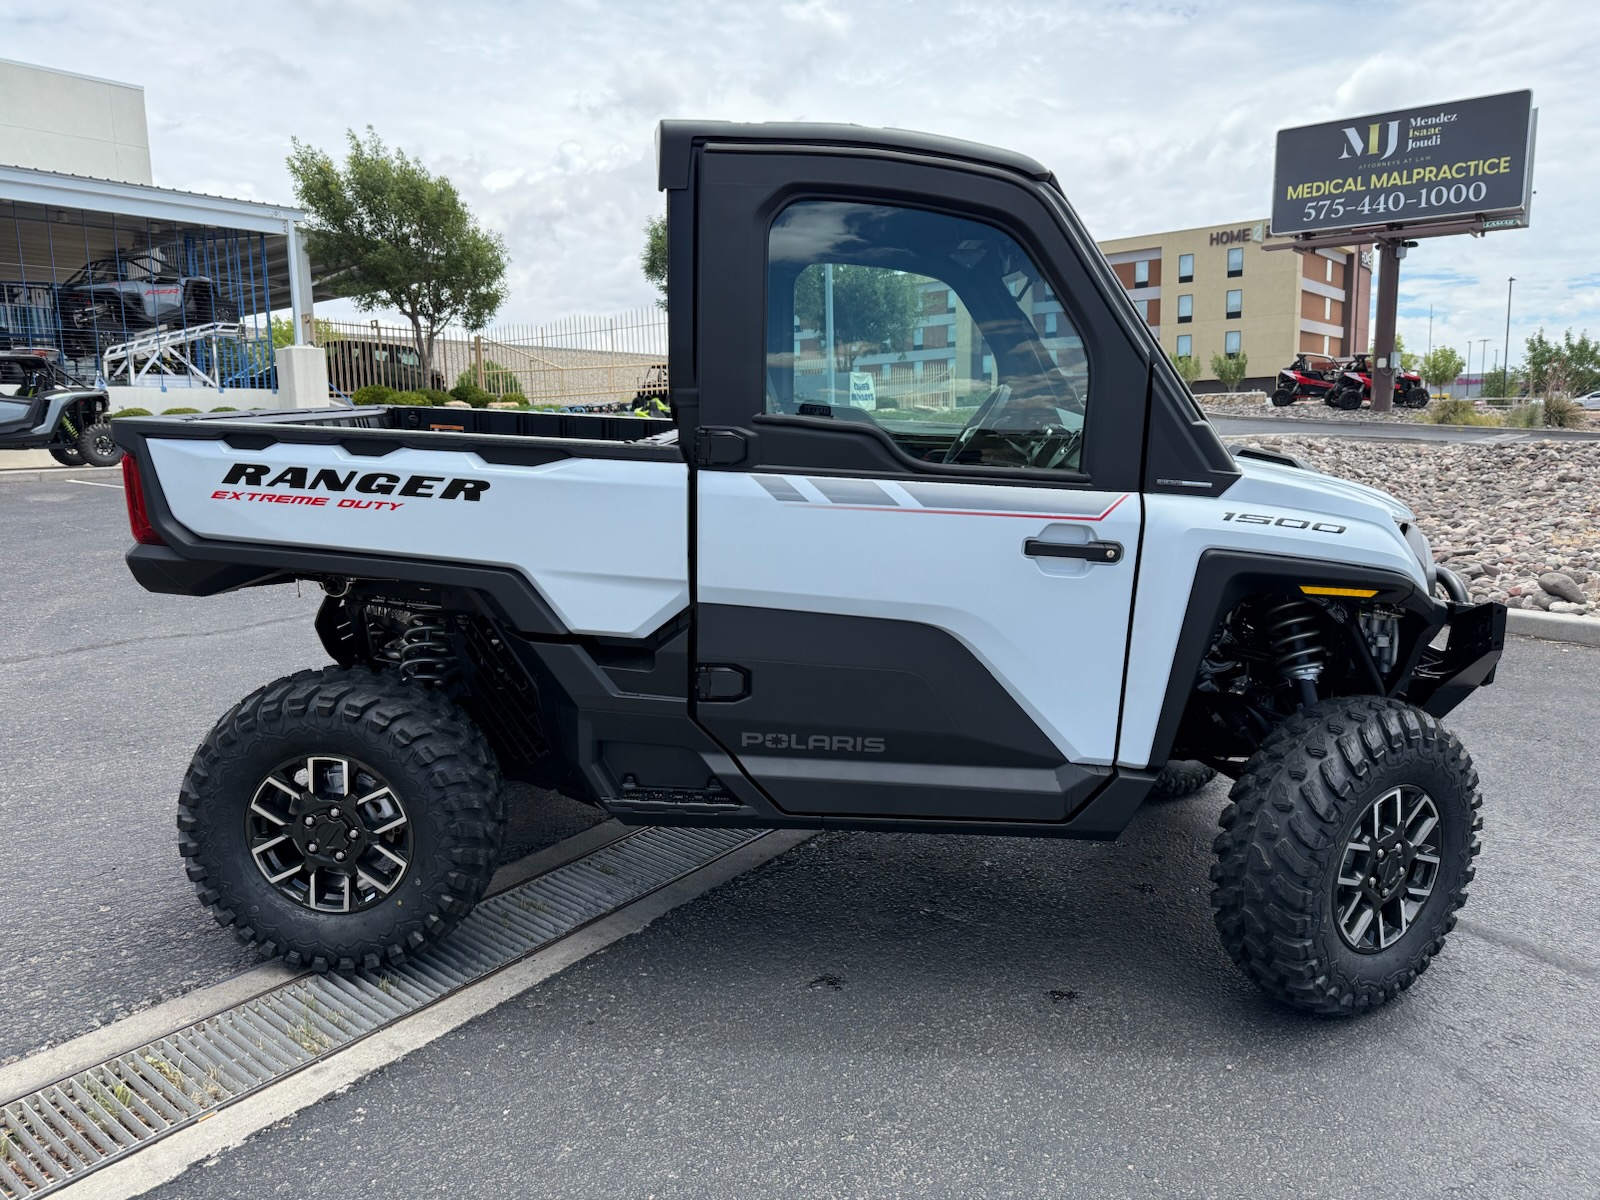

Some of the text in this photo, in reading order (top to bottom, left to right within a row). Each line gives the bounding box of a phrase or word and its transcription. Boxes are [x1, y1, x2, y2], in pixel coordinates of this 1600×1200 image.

[1409, 112, 1458, 128] Mendez
[1408, 126, 1442, 138] Isaac
[1406, 135, 1441, 153] Joudi
[1358, 155, 1432, 170] ATTORNEYS AT LAW
[1287, 156, 1511, 200] MEDICAL MALPRACTICE
[1303, 181, 1487, 222] 575-440-1000
[1210, 228, 1251, 246] HOME
[221, 463, 491, 501] RANGER
[210, 490, 405, 511] EXTREME DUTY
[1222, 512, 1347, 535] 1500
[741, 732, 886, 753] POLARIS
